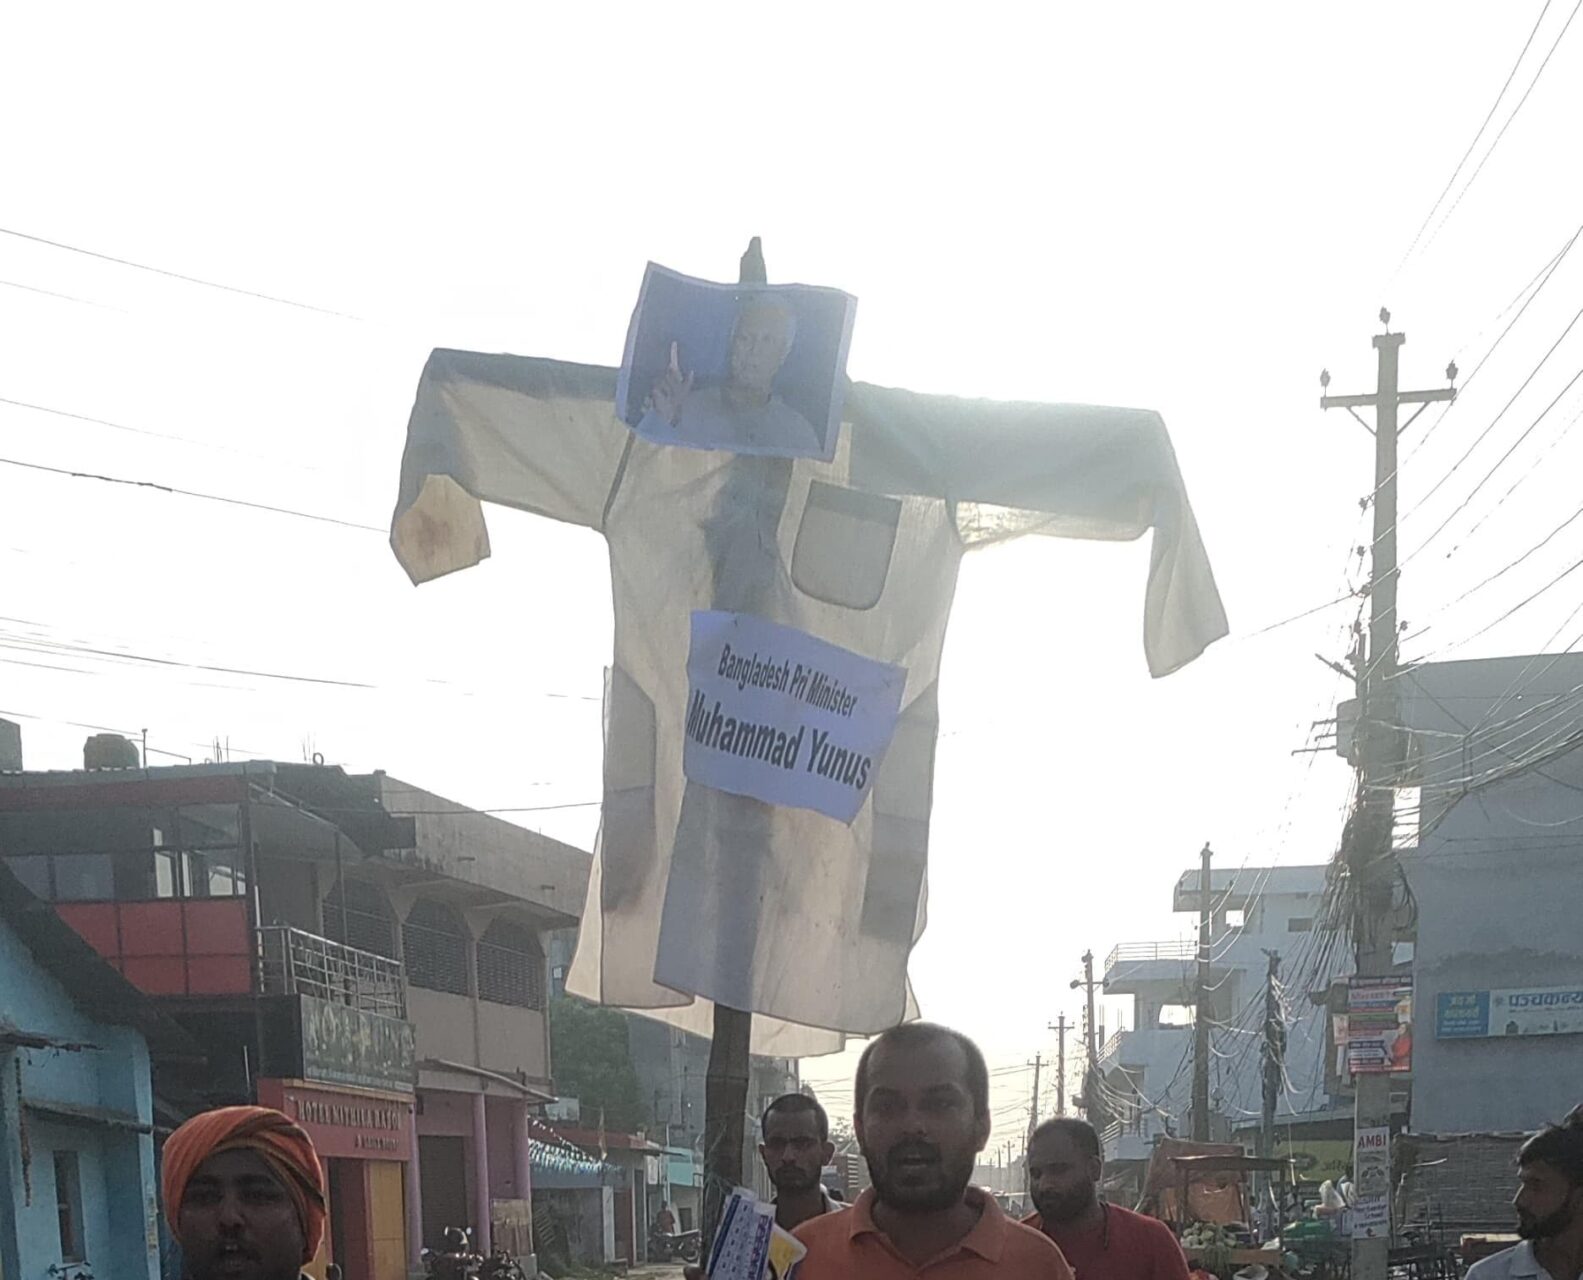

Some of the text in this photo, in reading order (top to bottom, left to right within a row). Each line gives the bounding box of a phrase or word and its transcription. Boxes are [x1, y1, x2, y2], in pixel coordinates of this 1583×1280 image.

[718, 643, 858, 718] Bangladesh Pri Minister
[686, 690, 872, 790] Muhammad Yunus
[298, 1100, 331, 1125] HOTEL
